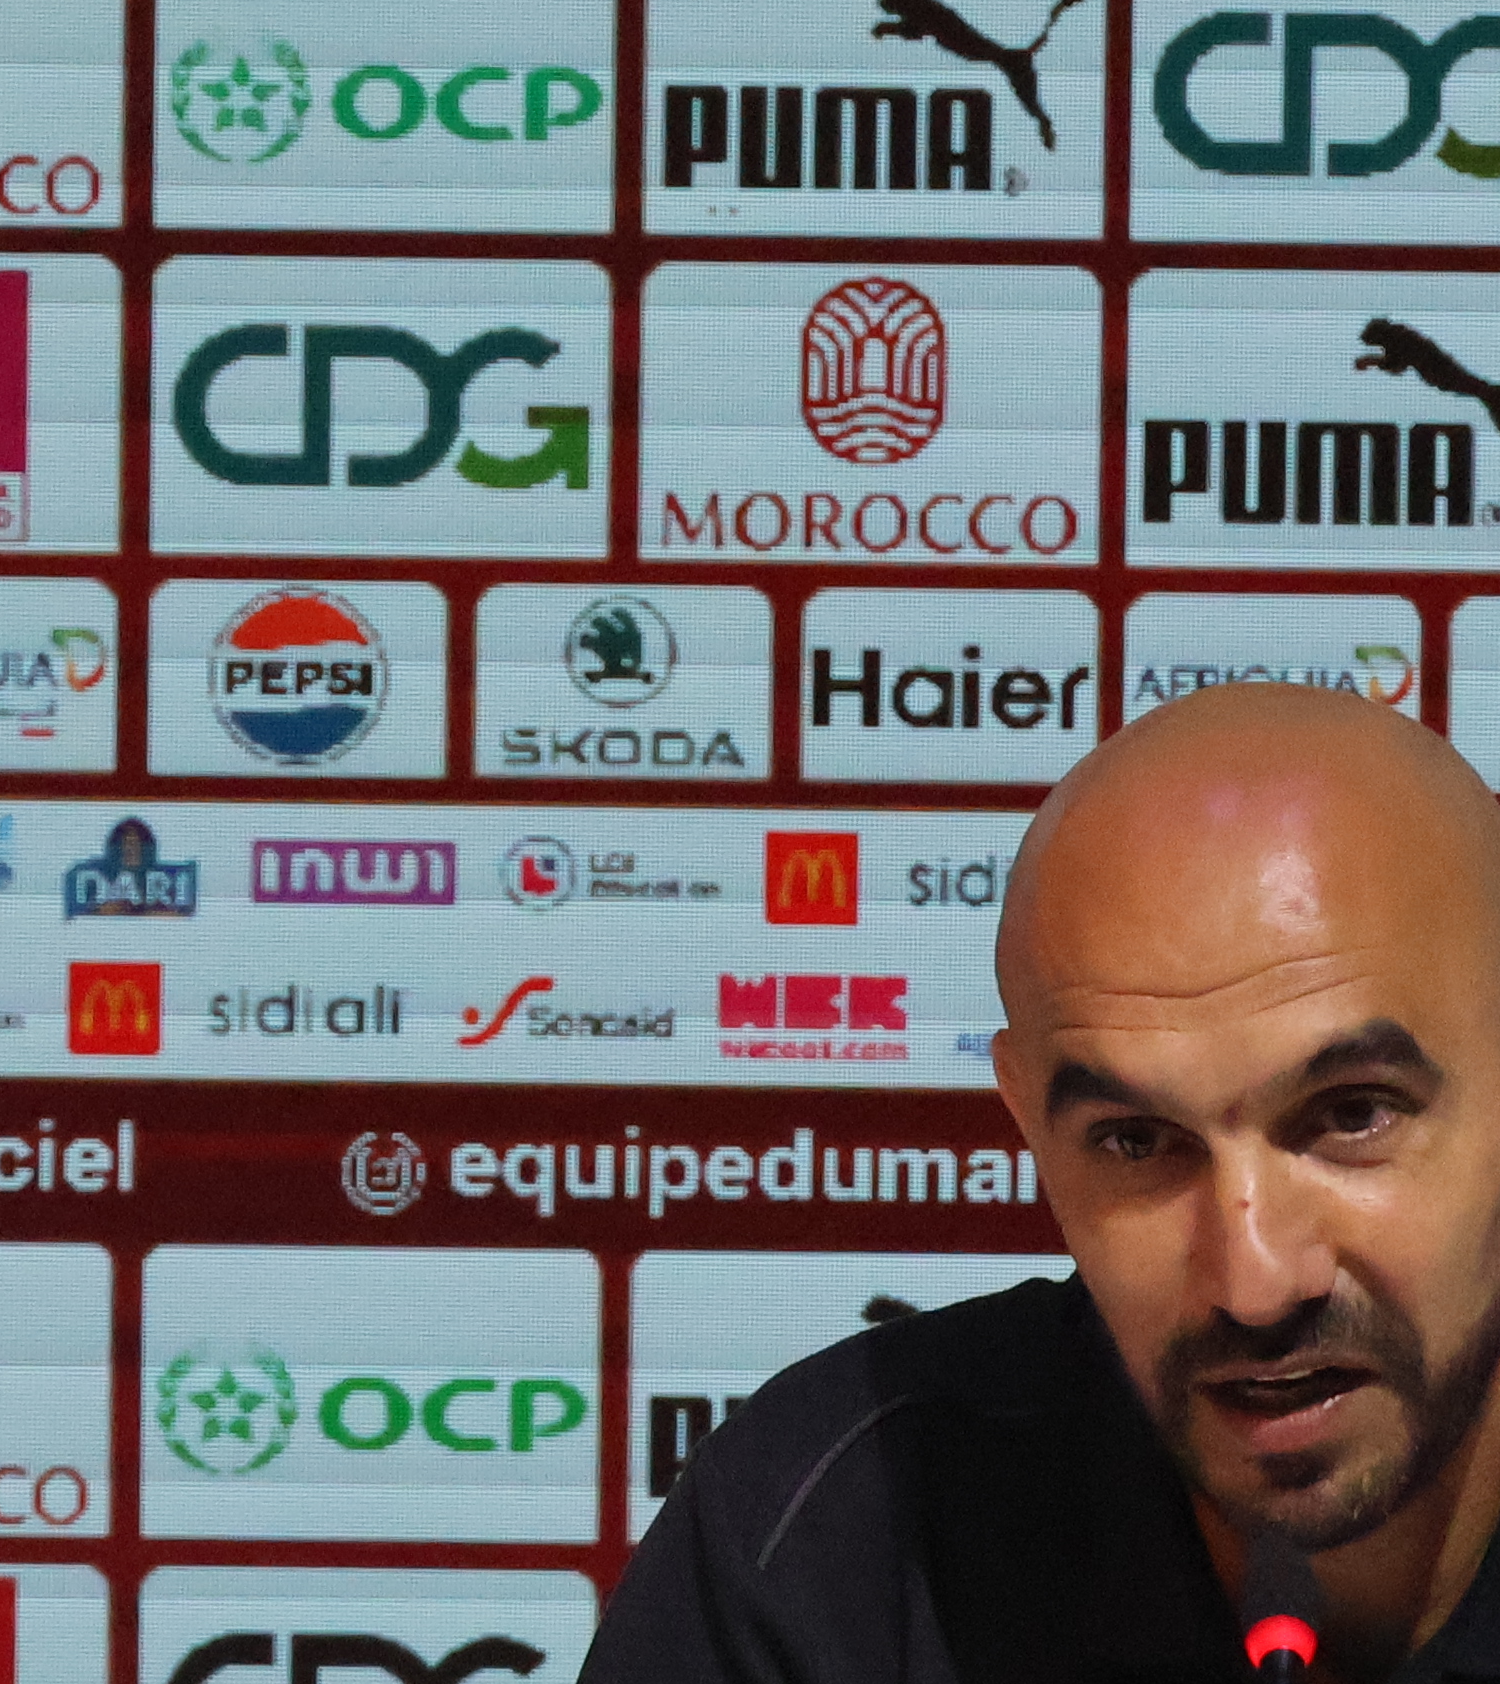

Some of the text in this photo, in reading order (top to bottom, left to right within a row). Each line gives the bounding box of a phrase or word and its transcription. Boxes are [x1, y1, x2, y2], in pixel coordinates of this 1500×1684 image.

[331, 65, 603, 142] OCP
[663, 85, 992, 191] PUMA
[173, 324, 590, 490] CDG
[1143, 420, 1474, 526] PUMA
[664, 494, 1078, 561] MOROCCO
[226, 661, 373, 695] PEPSI
[812, 646, 1089, 729] Haier
[78, 875, 195, 911] DARI
[259, 849, 450, 896] inwi
[318, 1377, 587, 1452] OCP
